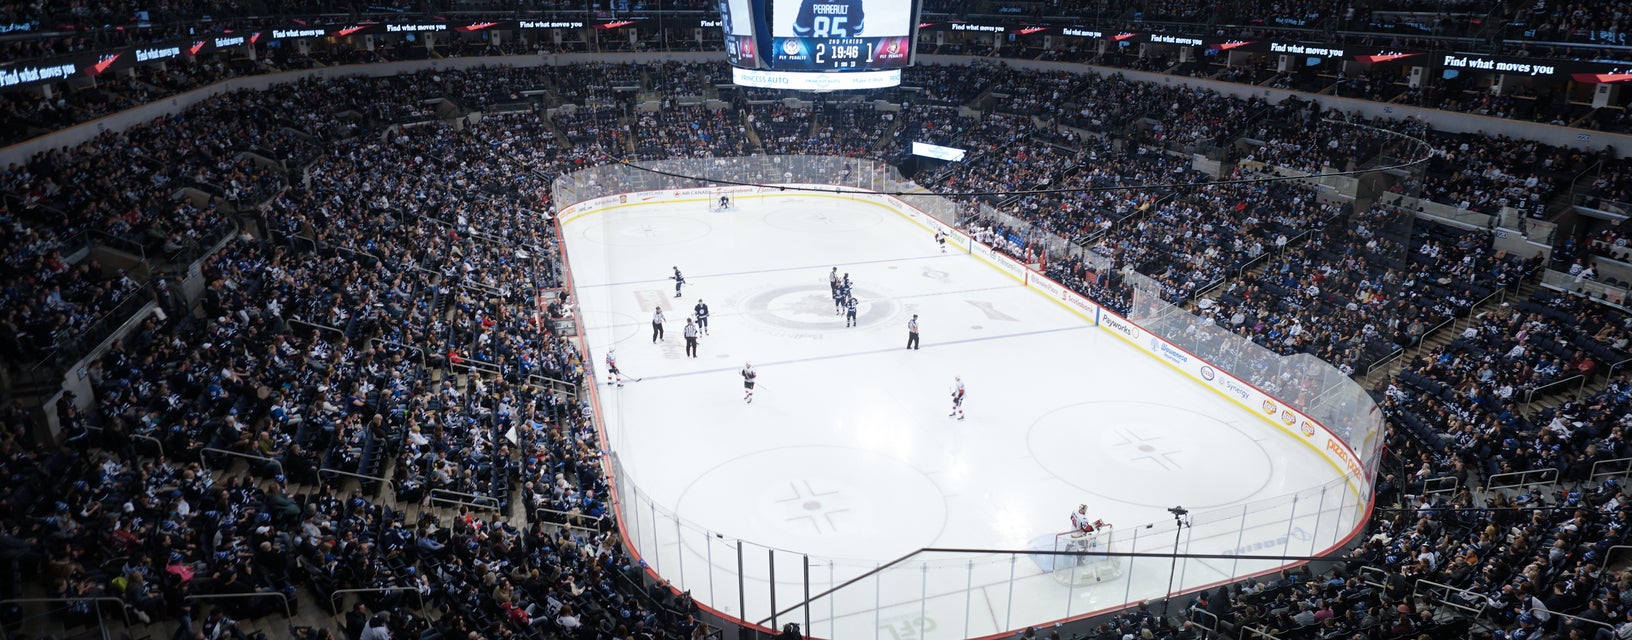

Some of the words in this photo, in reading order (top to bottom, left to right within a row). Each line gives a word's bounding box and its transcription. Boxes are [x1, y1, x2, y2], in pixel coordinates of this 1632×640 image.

[273, 30, 286, 38] Find
[814, 16, 848, 37] 85
[136, 49, 148, 61] Find
[148, 48, 159, 59] what
[171, 47, 180, 58] you
[816, 44, 825, 63] 2
[832, 46, 858, 58] 19:46
[866, 43, 873, 62] 1
[1271, 42, 1286, 52] Find
[1287, 44, 1304, 54] what
[1306, 47, 1328, 56] moves
[1328, 49, 1343, 58] you
[1444, 55, 1466, 68] Find
[1469, 58, 1494, 70] what
[1496, 62, 1530, 73] moves
[1531, 64, 1554, 76] you
[0, 68, 19, 87] Find
[19, 66, 39, 82] what
[40, 65, 62, 79] moves
[62, 64, 76, 79] you
[768, 76, 789, 84] AUTO
[1068, 295, 1093, 313] Scotiabank
[1103, 314, 1131, 336] Payworks
[1161, 343, 1188, 362] Wawanesa
[1226, 381, 1249, 399] Synergy
[1327, 438, 1348, 462] pizza
